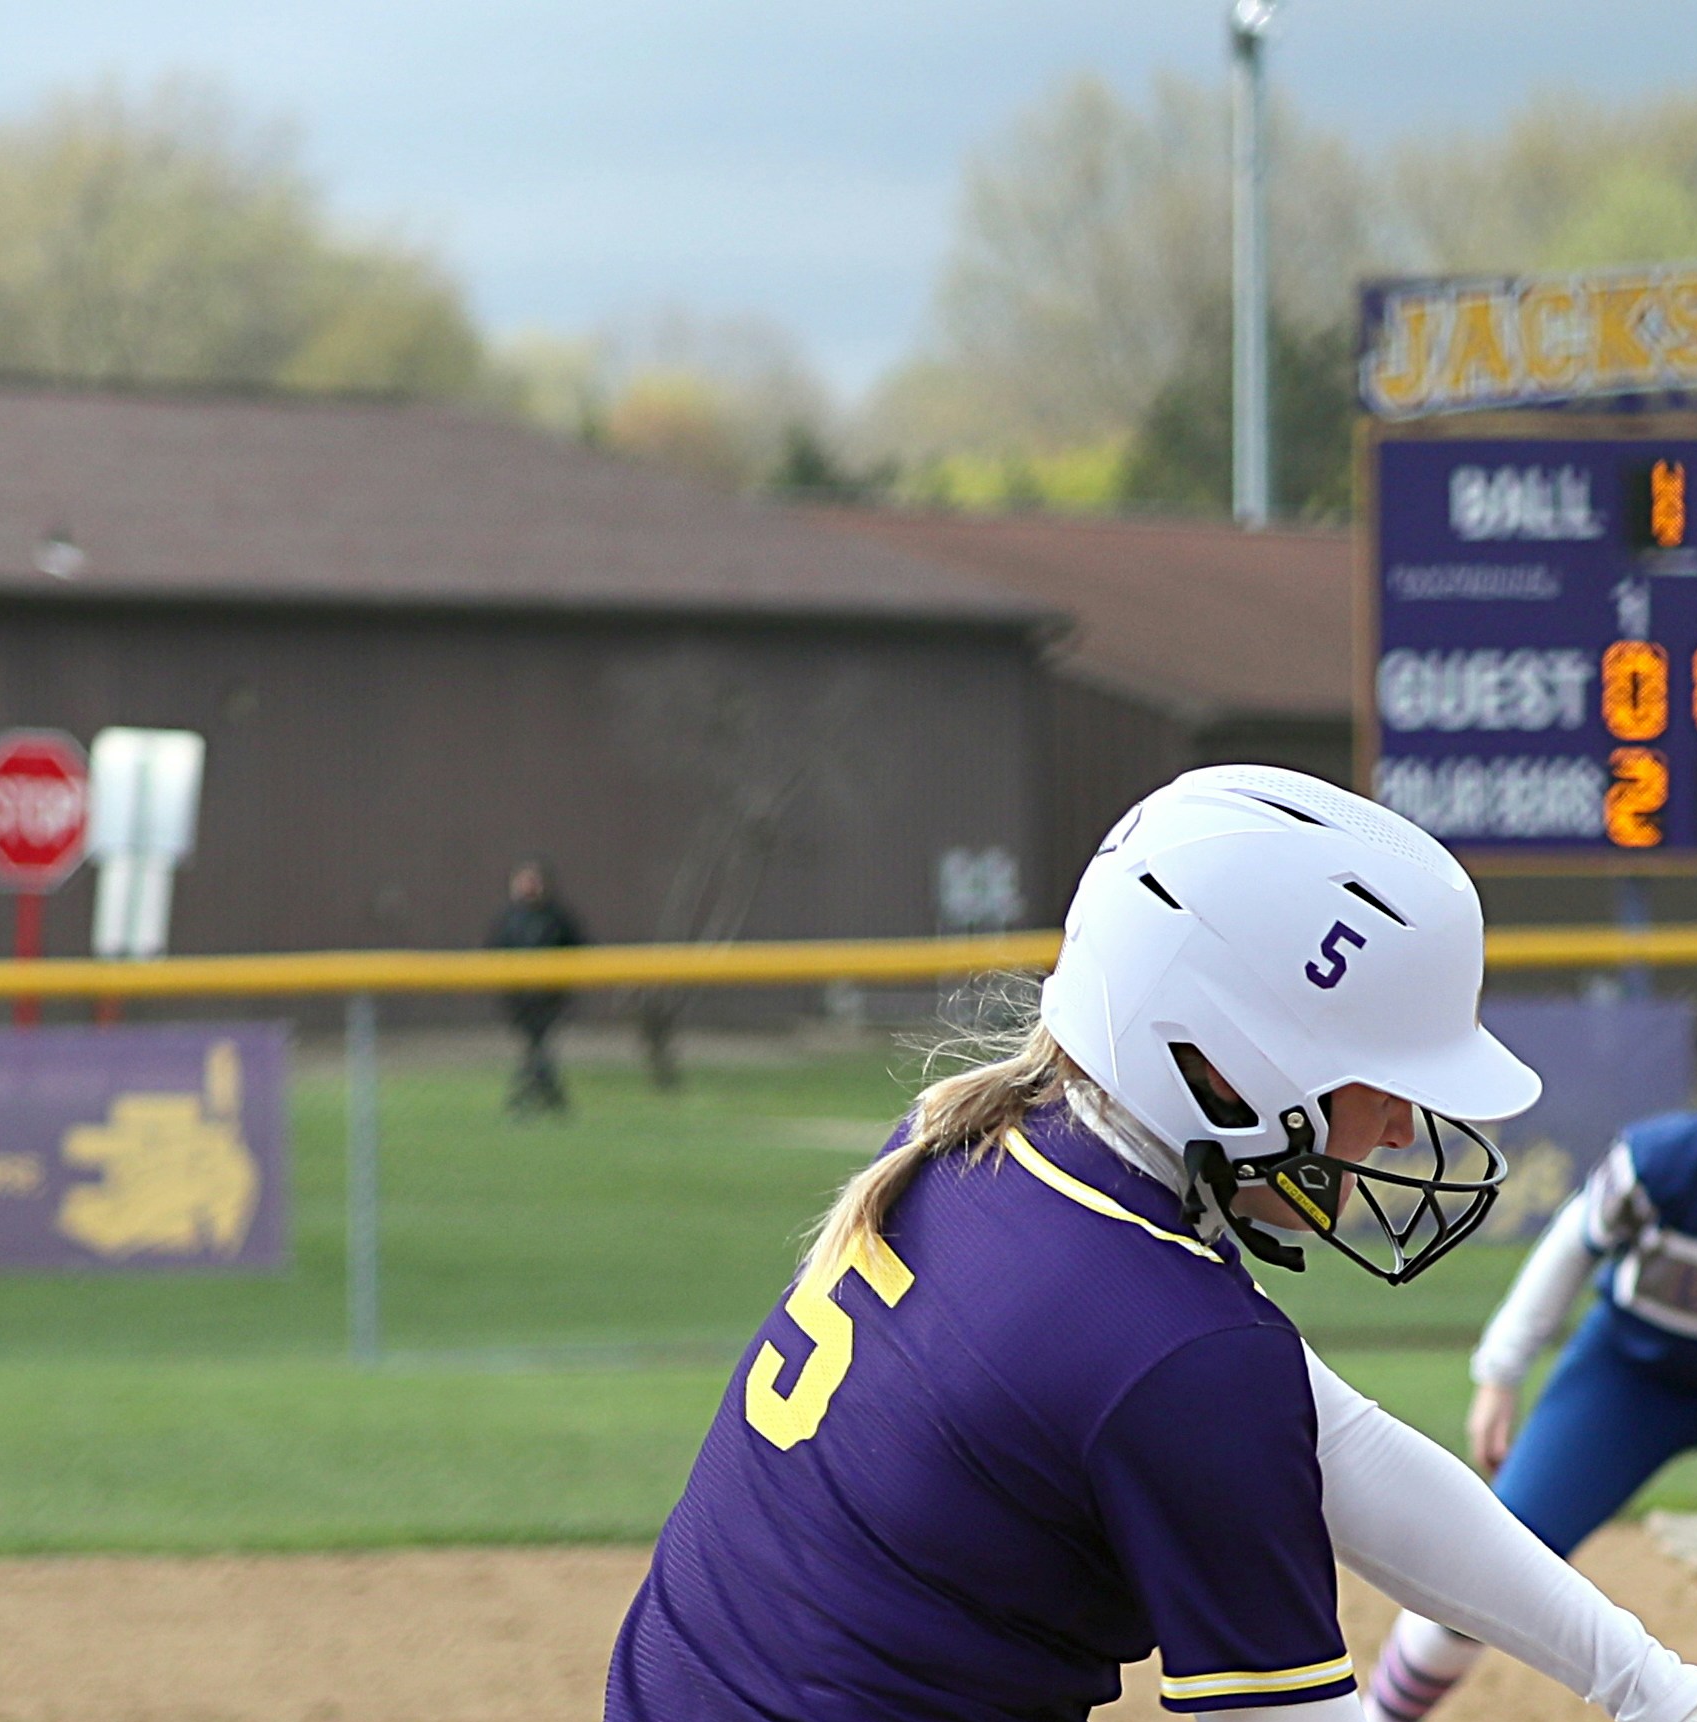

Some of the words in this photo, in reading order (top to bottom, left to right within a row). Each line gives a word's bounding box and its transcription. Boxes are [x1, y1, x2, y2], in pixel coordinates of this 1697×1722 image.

[1450, 464, 1603, 540] BALL
[1651, 459, 1686, 546] 1
[1612, 574, 1649, 641] 1
[1376, 650, 1595, 731] GUEST
[1601, 639, 1669, 741] 0
[1603, 745, 1669, 848] 2
[1304, 920, 1367, 989] 5
[744, 1235, 915, 1452] 5
